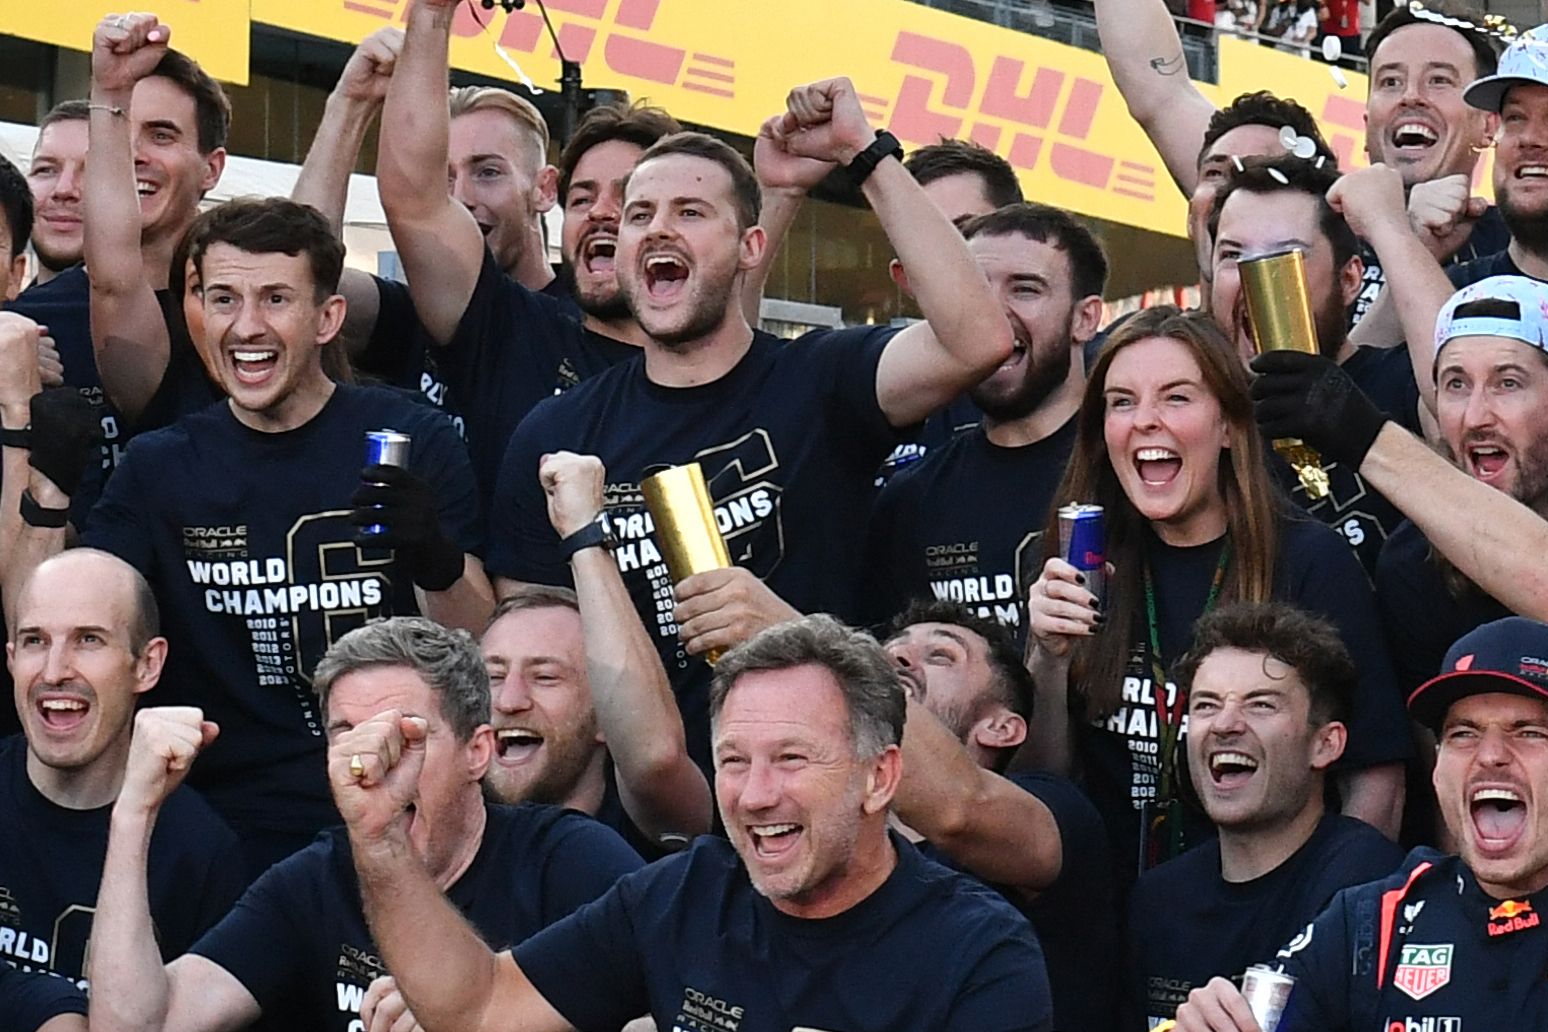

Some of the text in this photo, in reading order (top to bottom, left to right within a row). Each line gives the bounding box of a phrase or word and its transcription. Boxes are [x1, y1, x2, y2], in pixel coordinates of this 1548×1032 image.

[888, 30, 1114, 190] DHL
[183, 526, 247, 537] ORACLE
[187, 558, 285, 585] WORLD
[205, 579, 381, 615] CHAMPIONS
[930, 574, 1013, 604] WORLD
[247, 618, 276, 630] 2010
[251, 631, 277, 642] 2011
[252, 643, 279, 654] 2012
[1127, 741, 1158, 752] 2010
[1488, 912, 1540, 936] Red Bull
[0, 926, 49, 964] RLD
[1402, 949, 1448, 965] TAG
[1396, 967, 1447, 992] HEUER
[684, 987, 745, 1019] ORACLE
